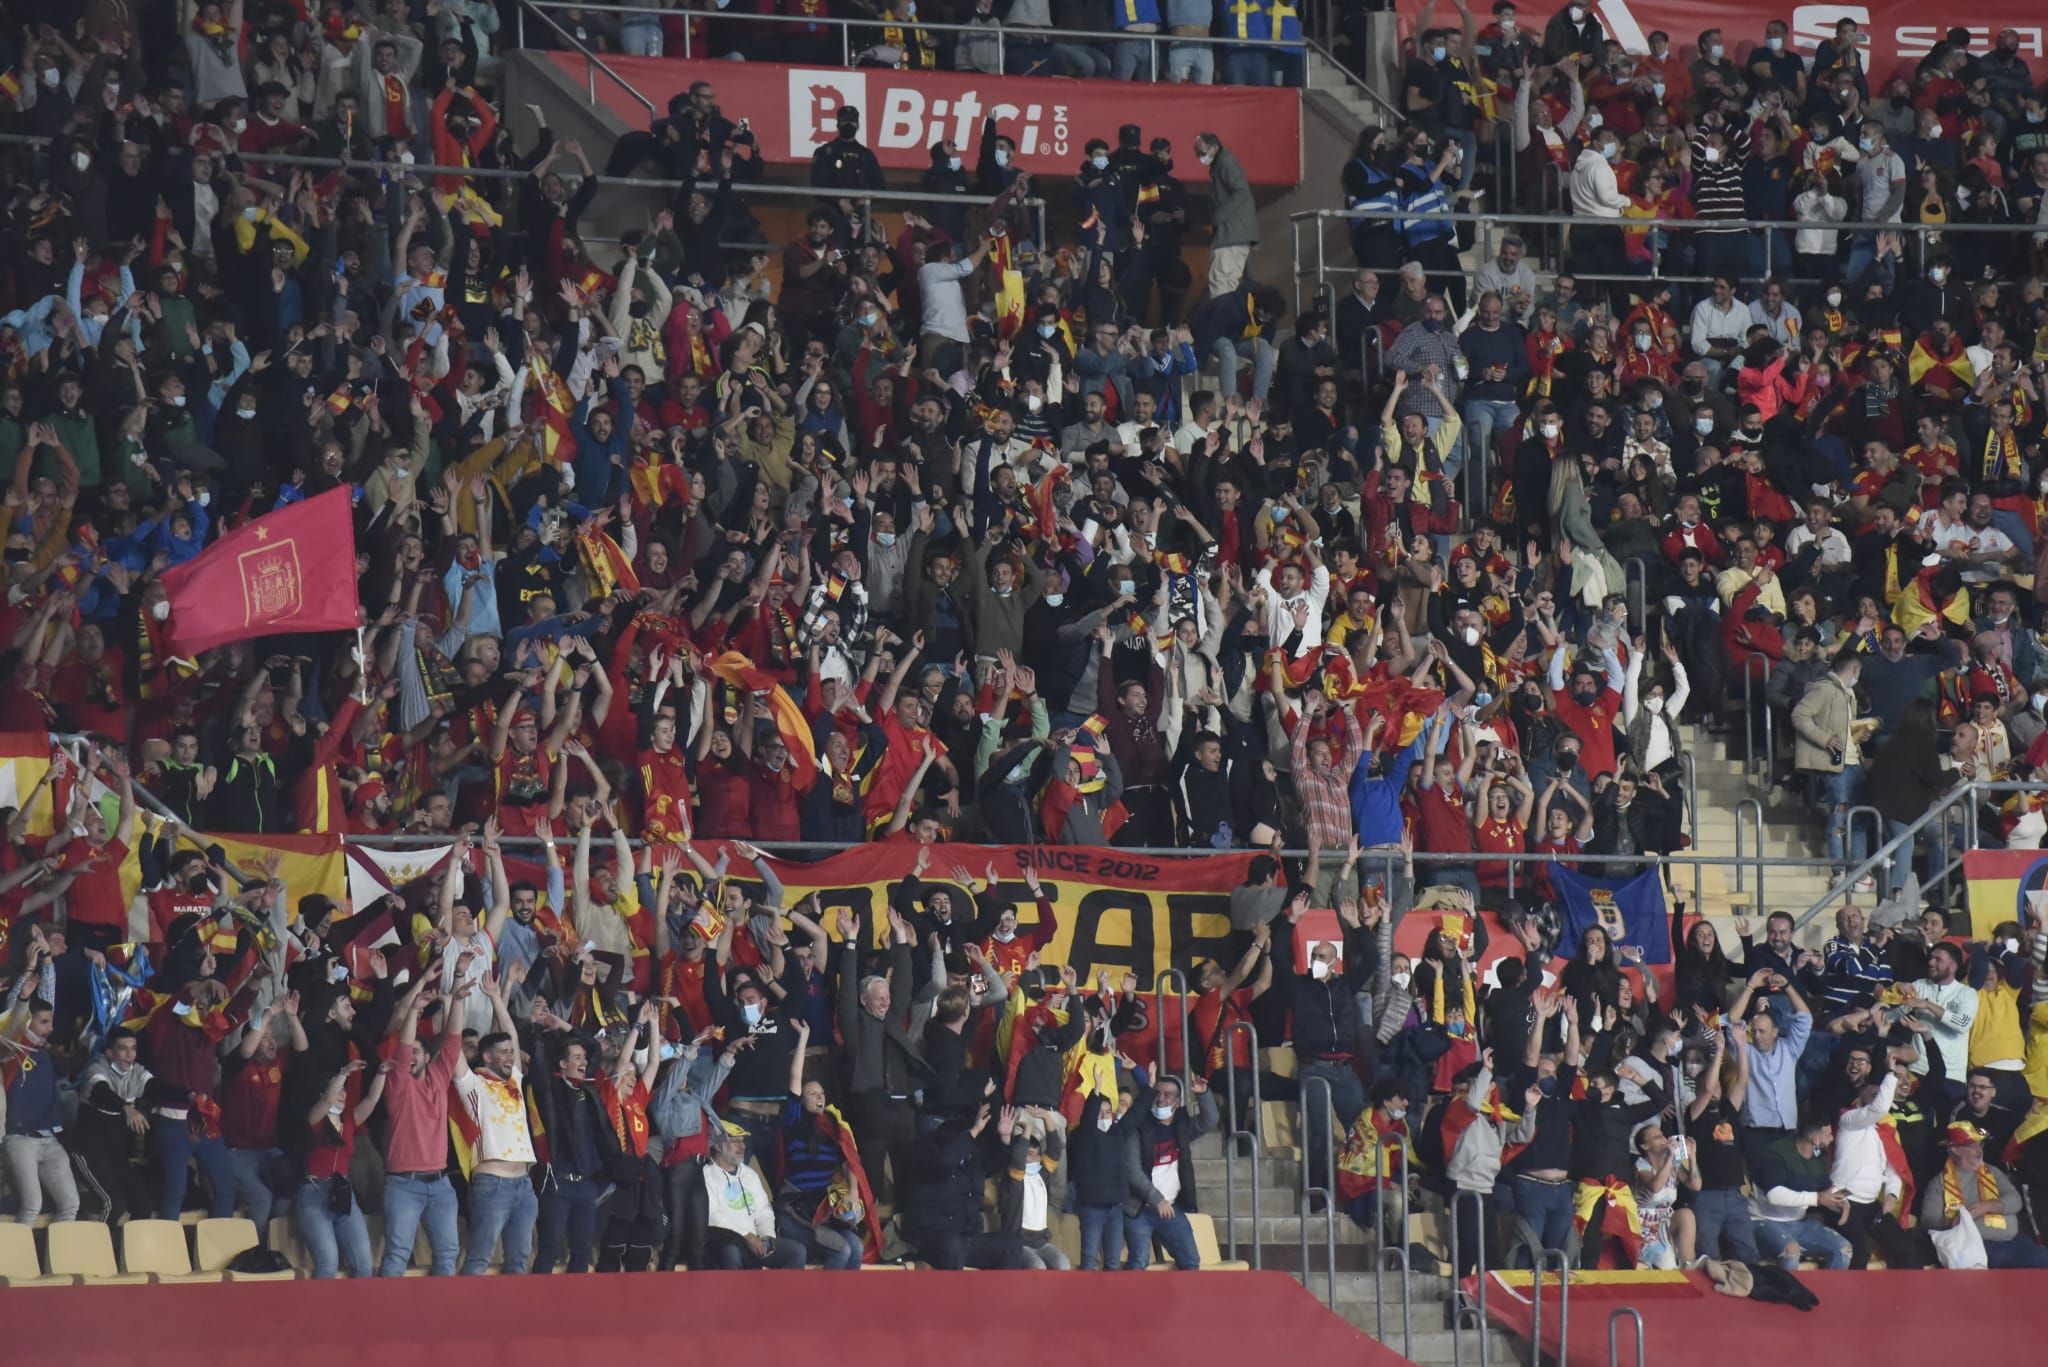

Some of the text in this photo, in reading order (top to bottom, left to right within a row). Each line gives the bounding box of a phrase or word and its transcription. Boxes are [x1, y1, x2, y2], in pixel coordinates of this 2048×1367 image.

[878, 87, 1042, 155] Bitci
[1015, 848, 1161, 881] SINCE 2012
